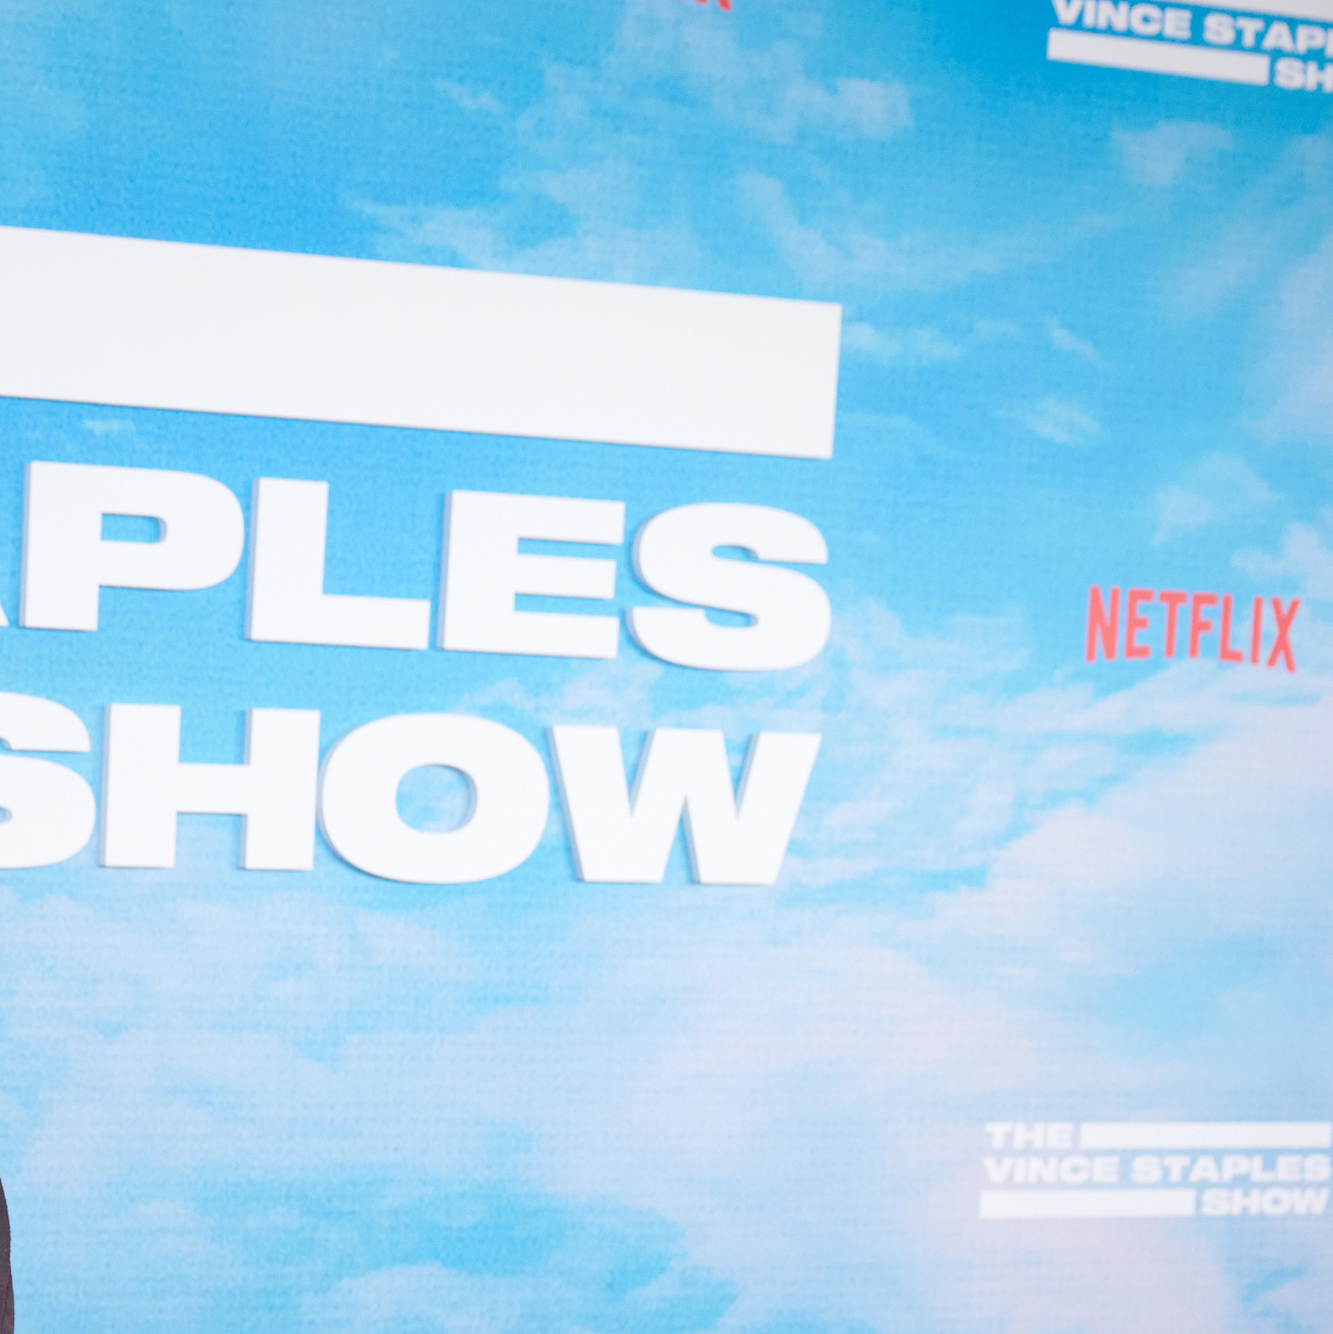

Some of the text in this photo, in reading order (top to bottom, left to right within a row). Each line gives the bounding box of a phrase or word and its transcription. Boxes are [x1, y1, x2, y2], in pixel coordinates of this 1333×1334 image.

[1051, 0, 1333, 59] VINCE STAP
[1274, 57, 1333, 94] SH
[1086, 585, 1301, 673] NETFLIX
[984, 1121, 1075, 1150] THE
[983, 1153, 1333, 1185] VINCE STAPLES
[1201, 1187, 1331, 1217] SHOW
